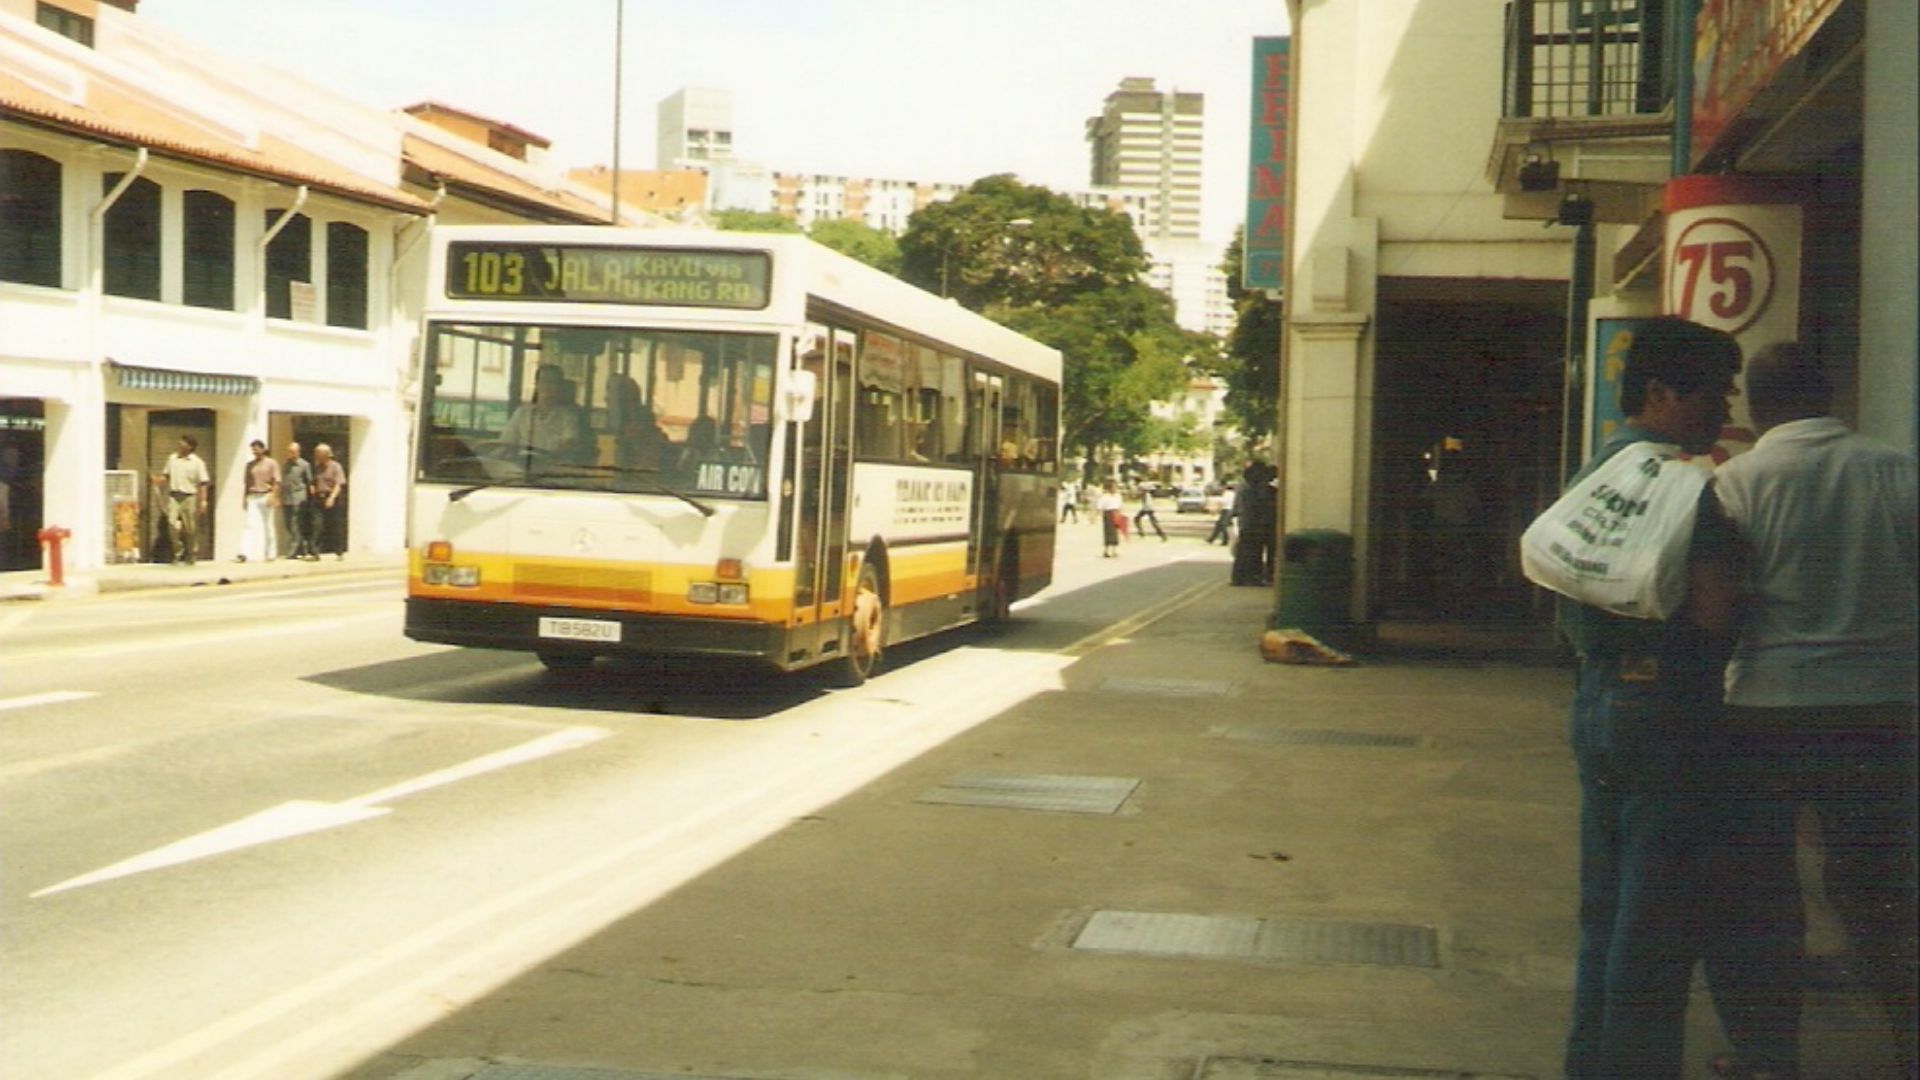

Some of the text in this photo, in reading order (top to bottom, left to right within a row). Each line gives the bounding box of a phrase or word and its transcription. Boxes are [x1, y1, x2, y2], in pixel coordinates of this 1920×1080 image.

[463, 252, 630, 294] 103 JALA
[634, 255, 742, 279] KAYU via
[1678, 240, 1755, 320] 75
[696, 464, 724, 490] AIR
